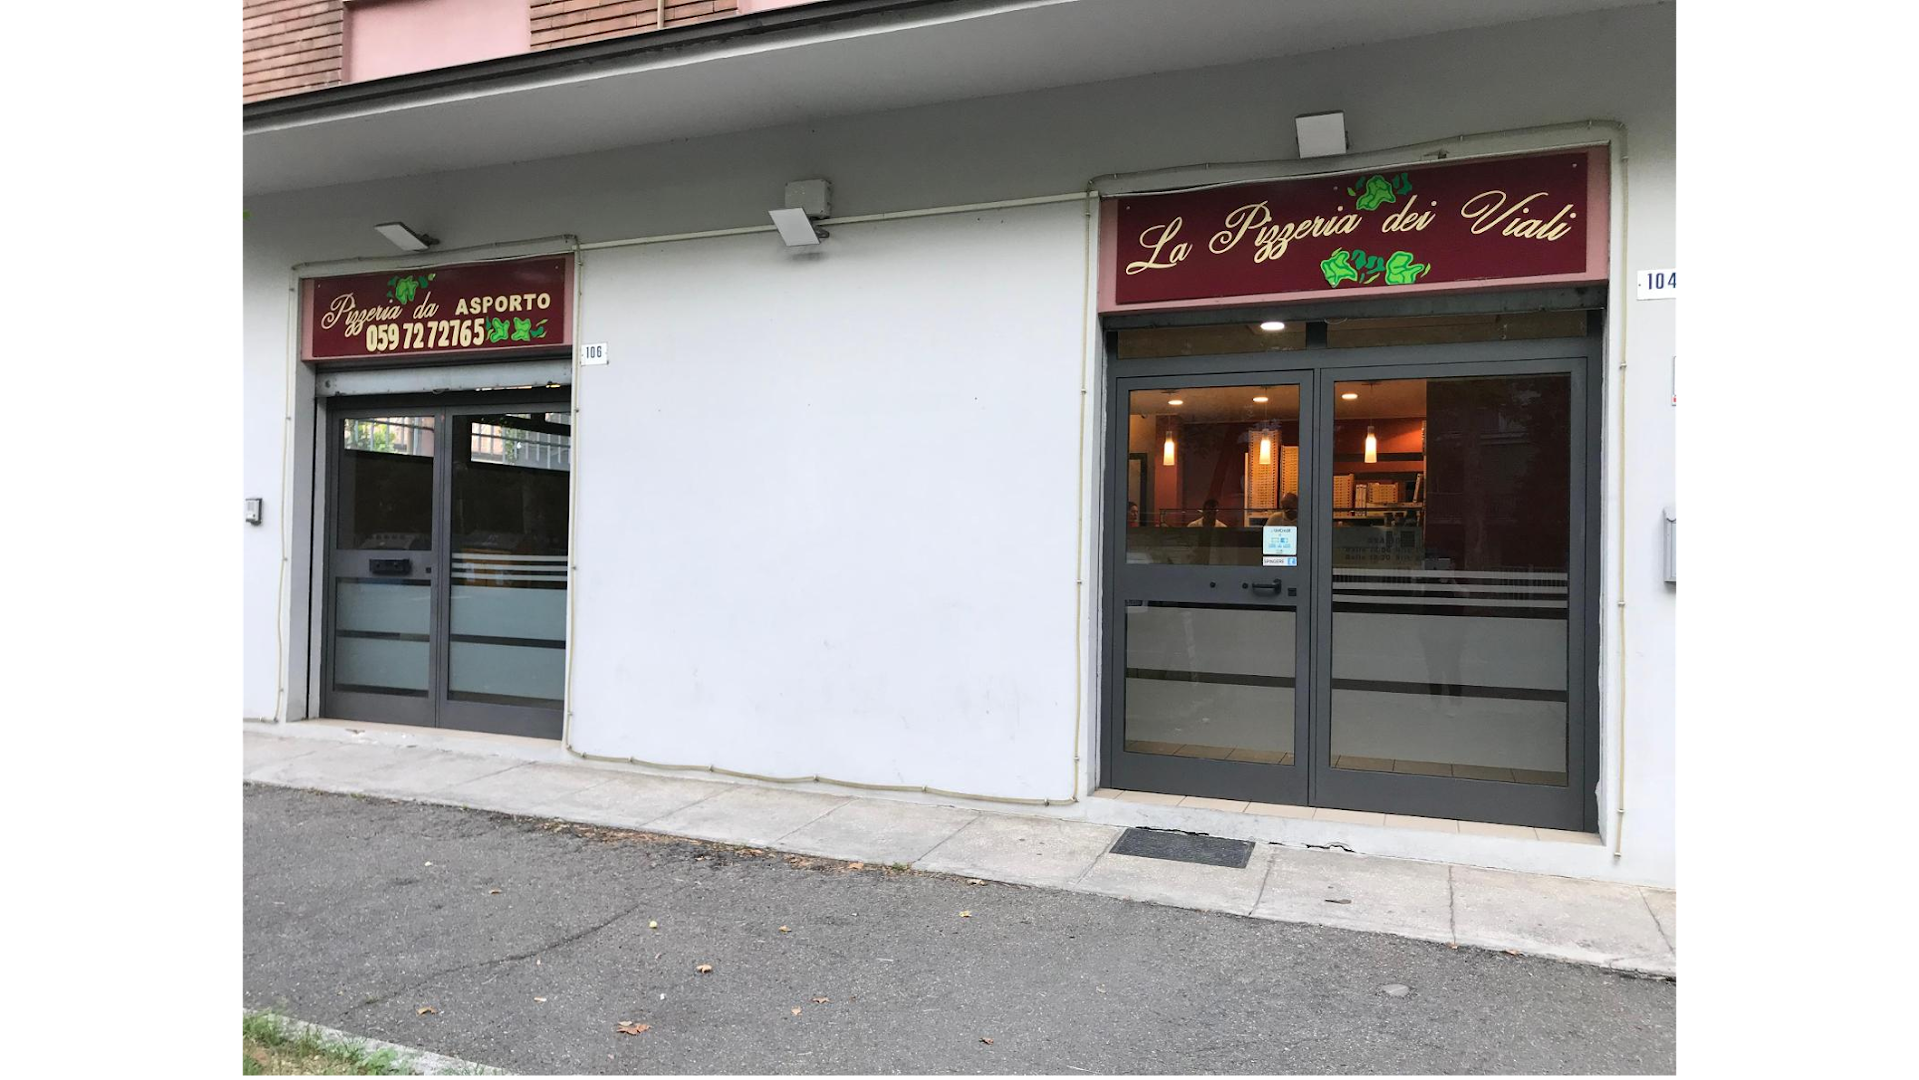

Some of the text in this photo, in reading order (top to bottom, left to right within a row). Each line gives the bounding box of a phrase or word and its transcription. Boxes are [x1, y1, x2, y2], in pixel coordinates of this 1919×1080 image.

[1126, 190, 1577, 275] La Pizzeria dei Viali
[1647, 272, 1677, 290] 104
[321, 291, 551, 338] Pizzeria da ASPORTO
[366, 322, 399, 352] 059
[586, 345, 602, 359] 106
